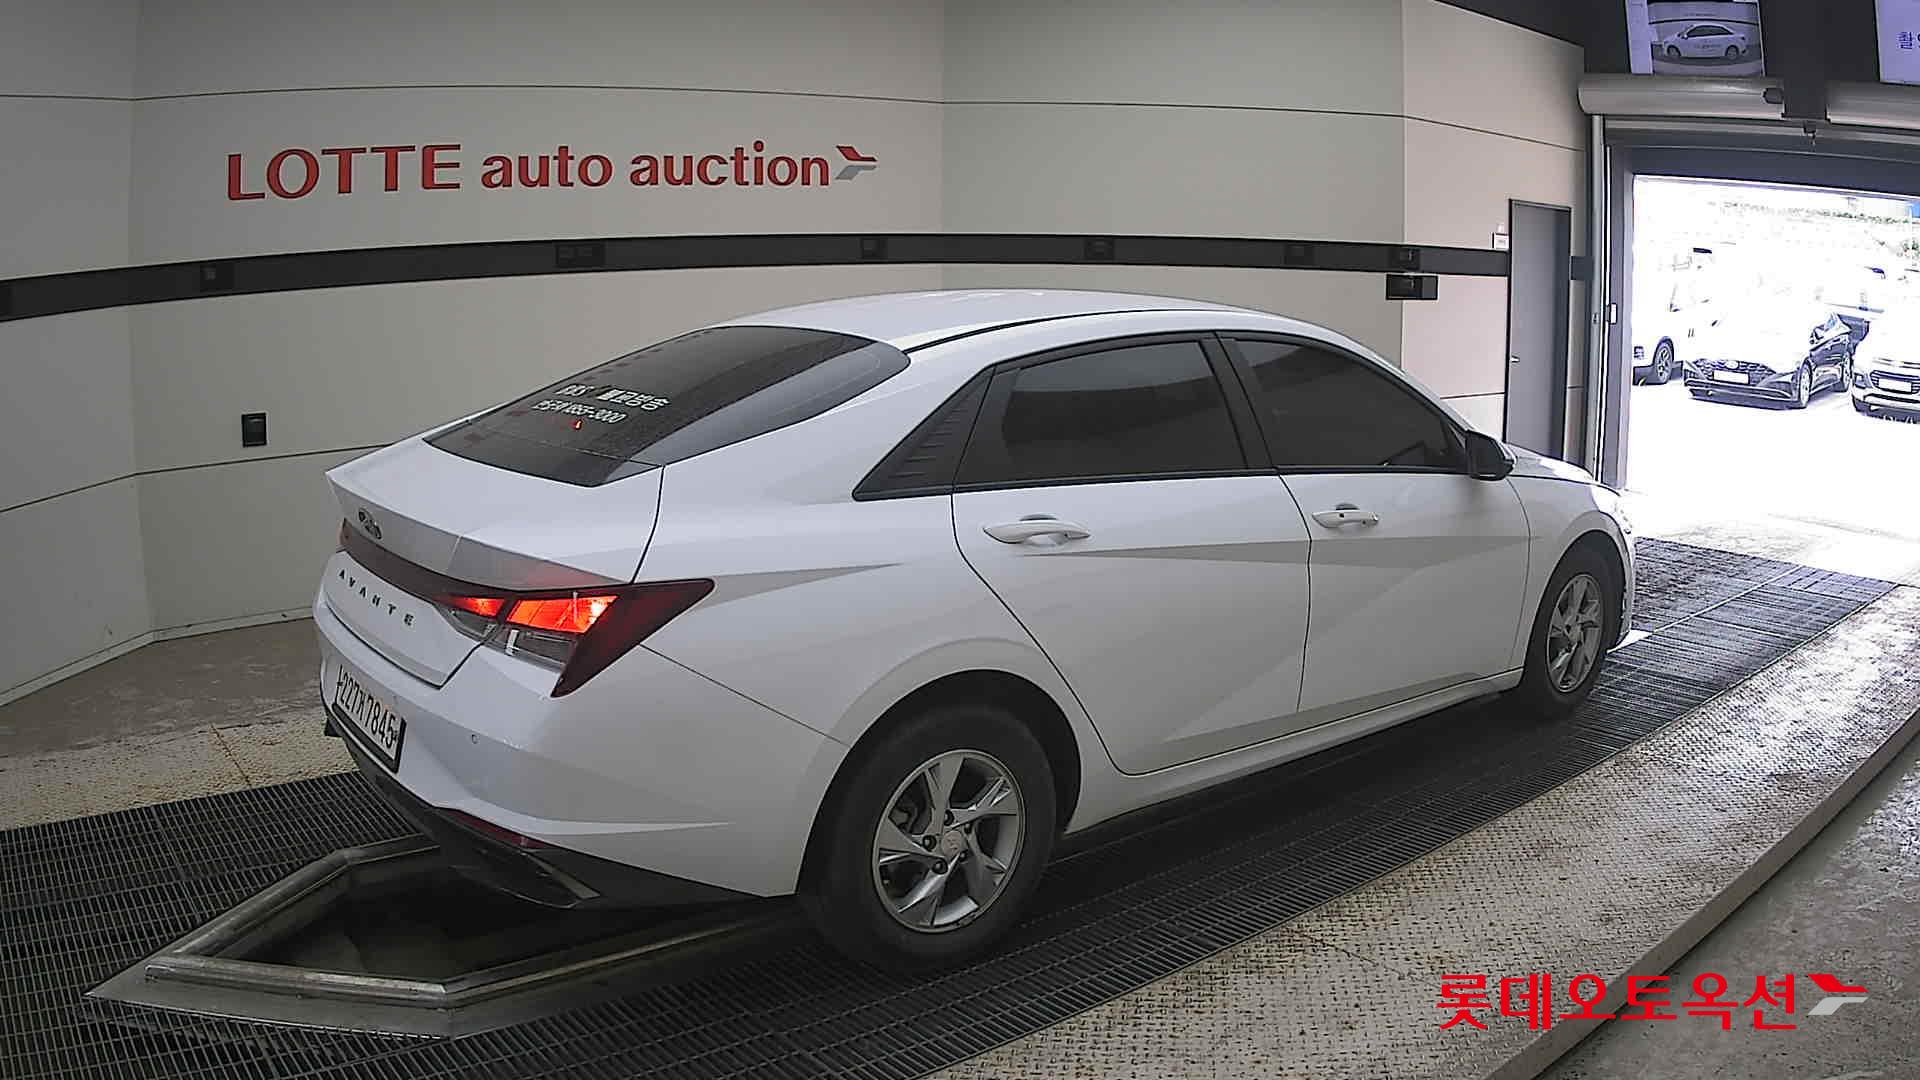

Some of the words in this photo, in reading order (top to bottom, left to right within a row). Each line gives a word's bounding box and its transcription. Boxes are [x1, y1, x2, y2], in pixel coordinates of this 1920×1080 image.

[227, 144, 461, 201] LOTTE
[480, 145, 614, 189] auto
[629, 140, 830, 187] auction
[338, 569, 414, 626] AVANTE
